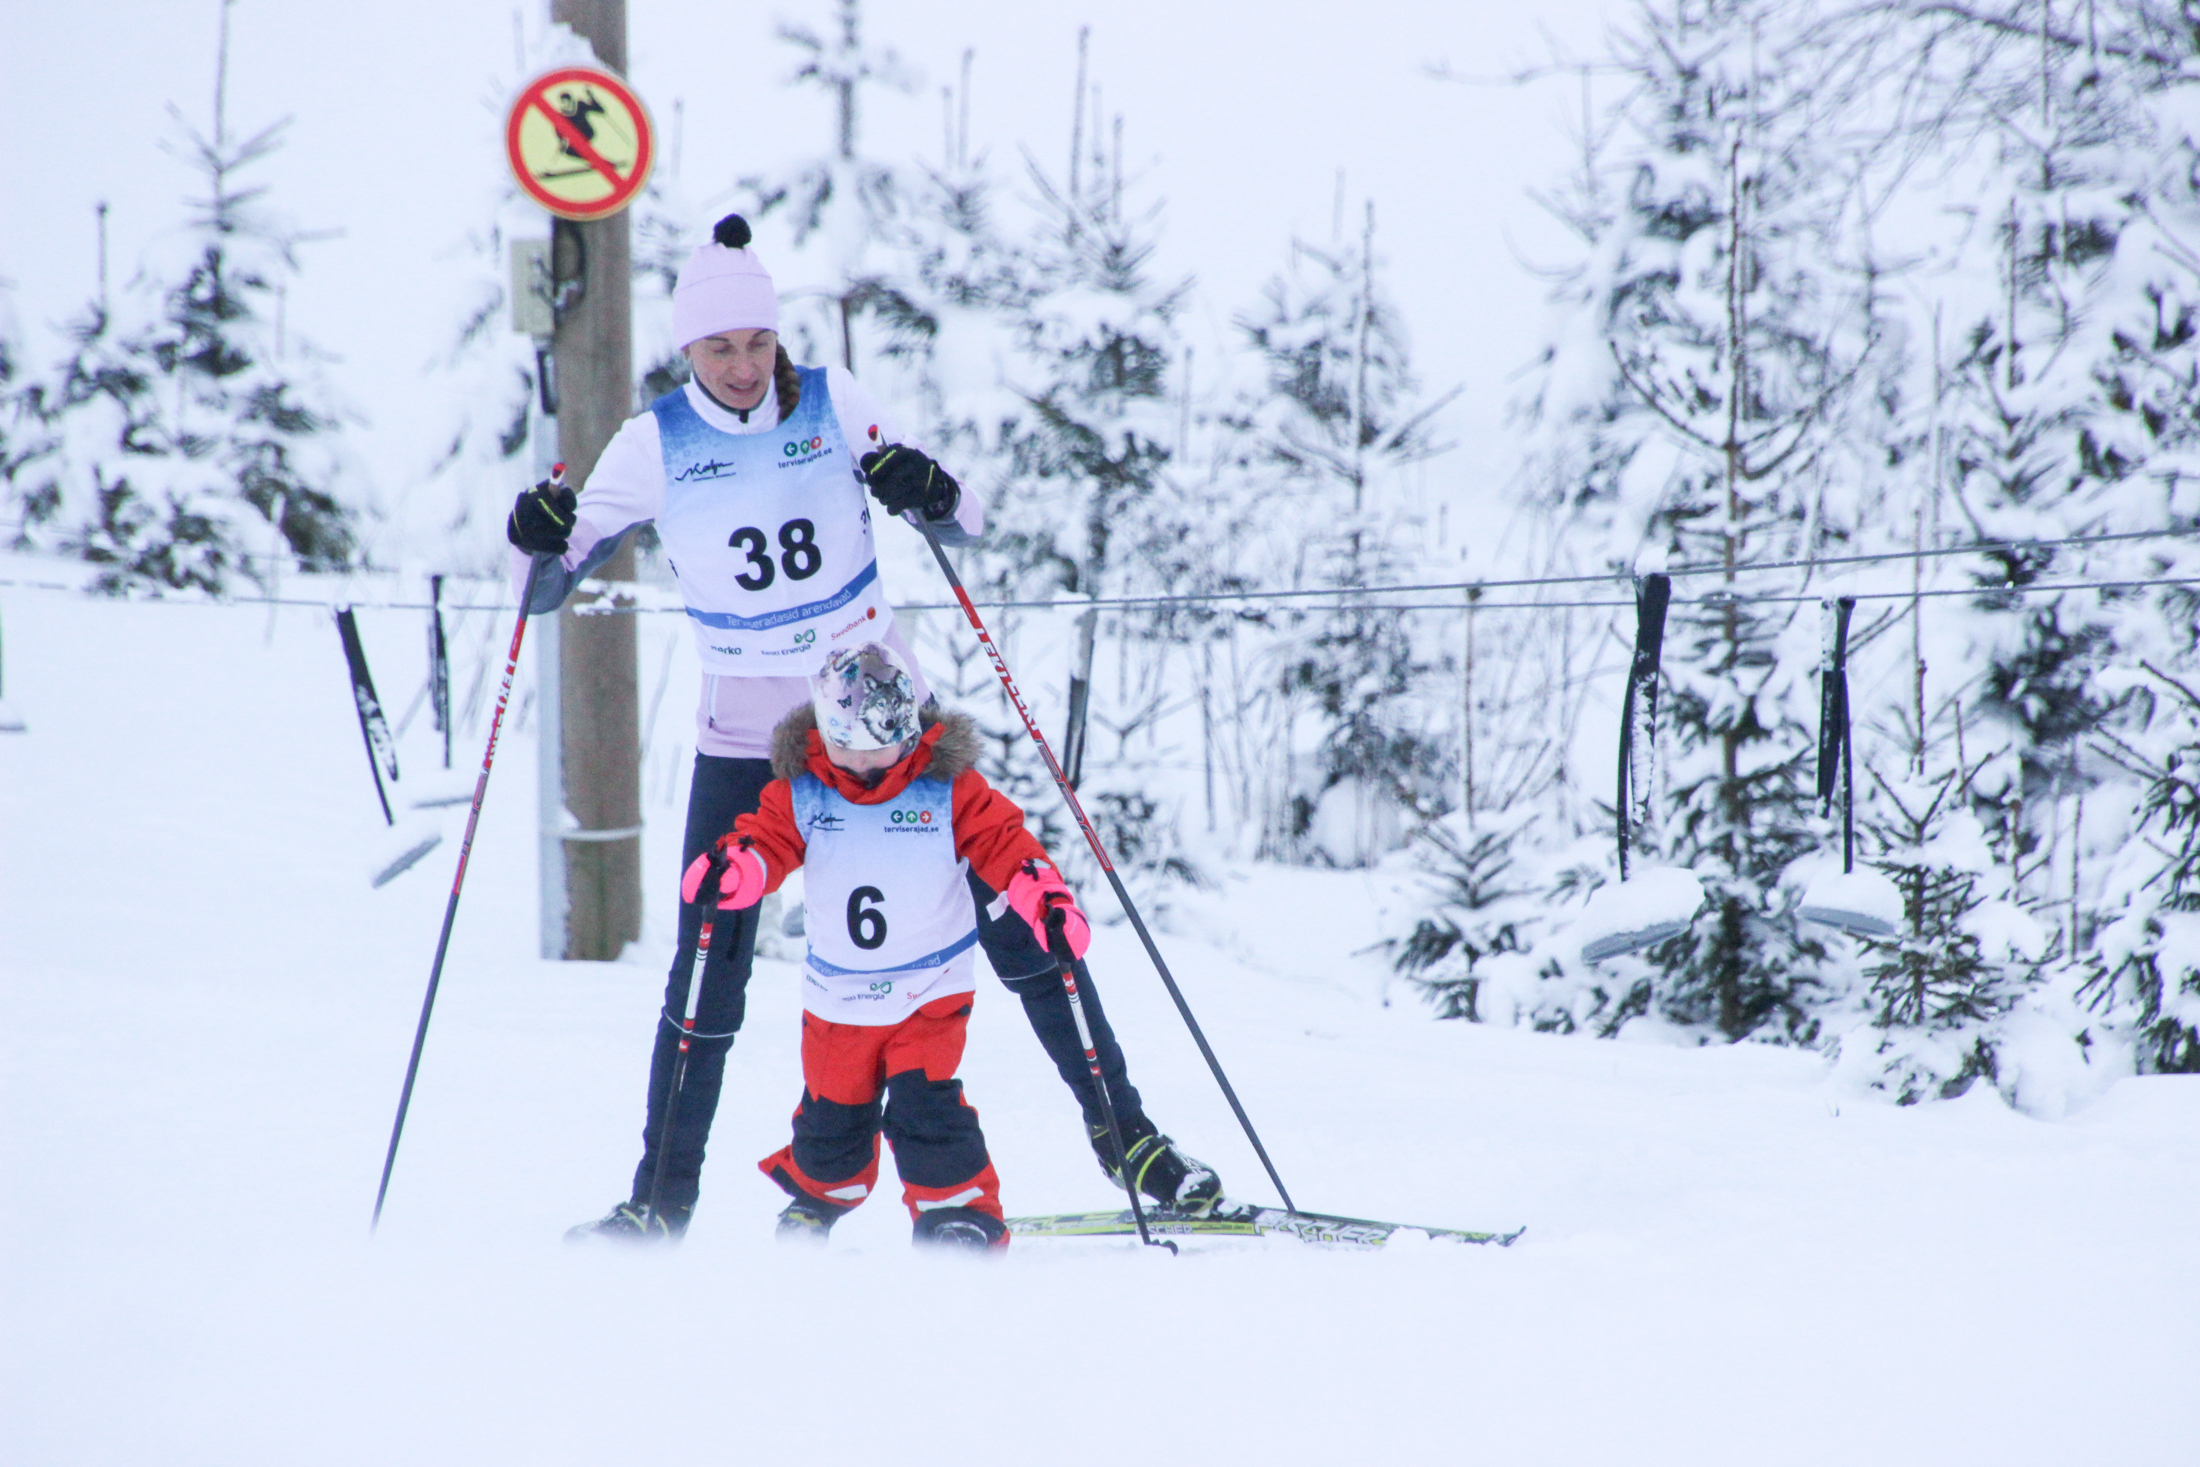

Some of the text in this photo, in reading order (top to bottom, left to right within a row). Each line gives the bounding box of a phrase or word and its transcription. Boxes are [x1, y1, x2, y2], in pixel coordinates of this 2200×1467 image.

[728, 518, 822, 592] 38
[802, 589, 852, 620] arendavad
[831, 615, 867, 641] Swedbank
[781, 644, 811, 656] Energia
[847, 885, 887, 950] 6
[1134, 1224, 1193, 1236] FSCHER
